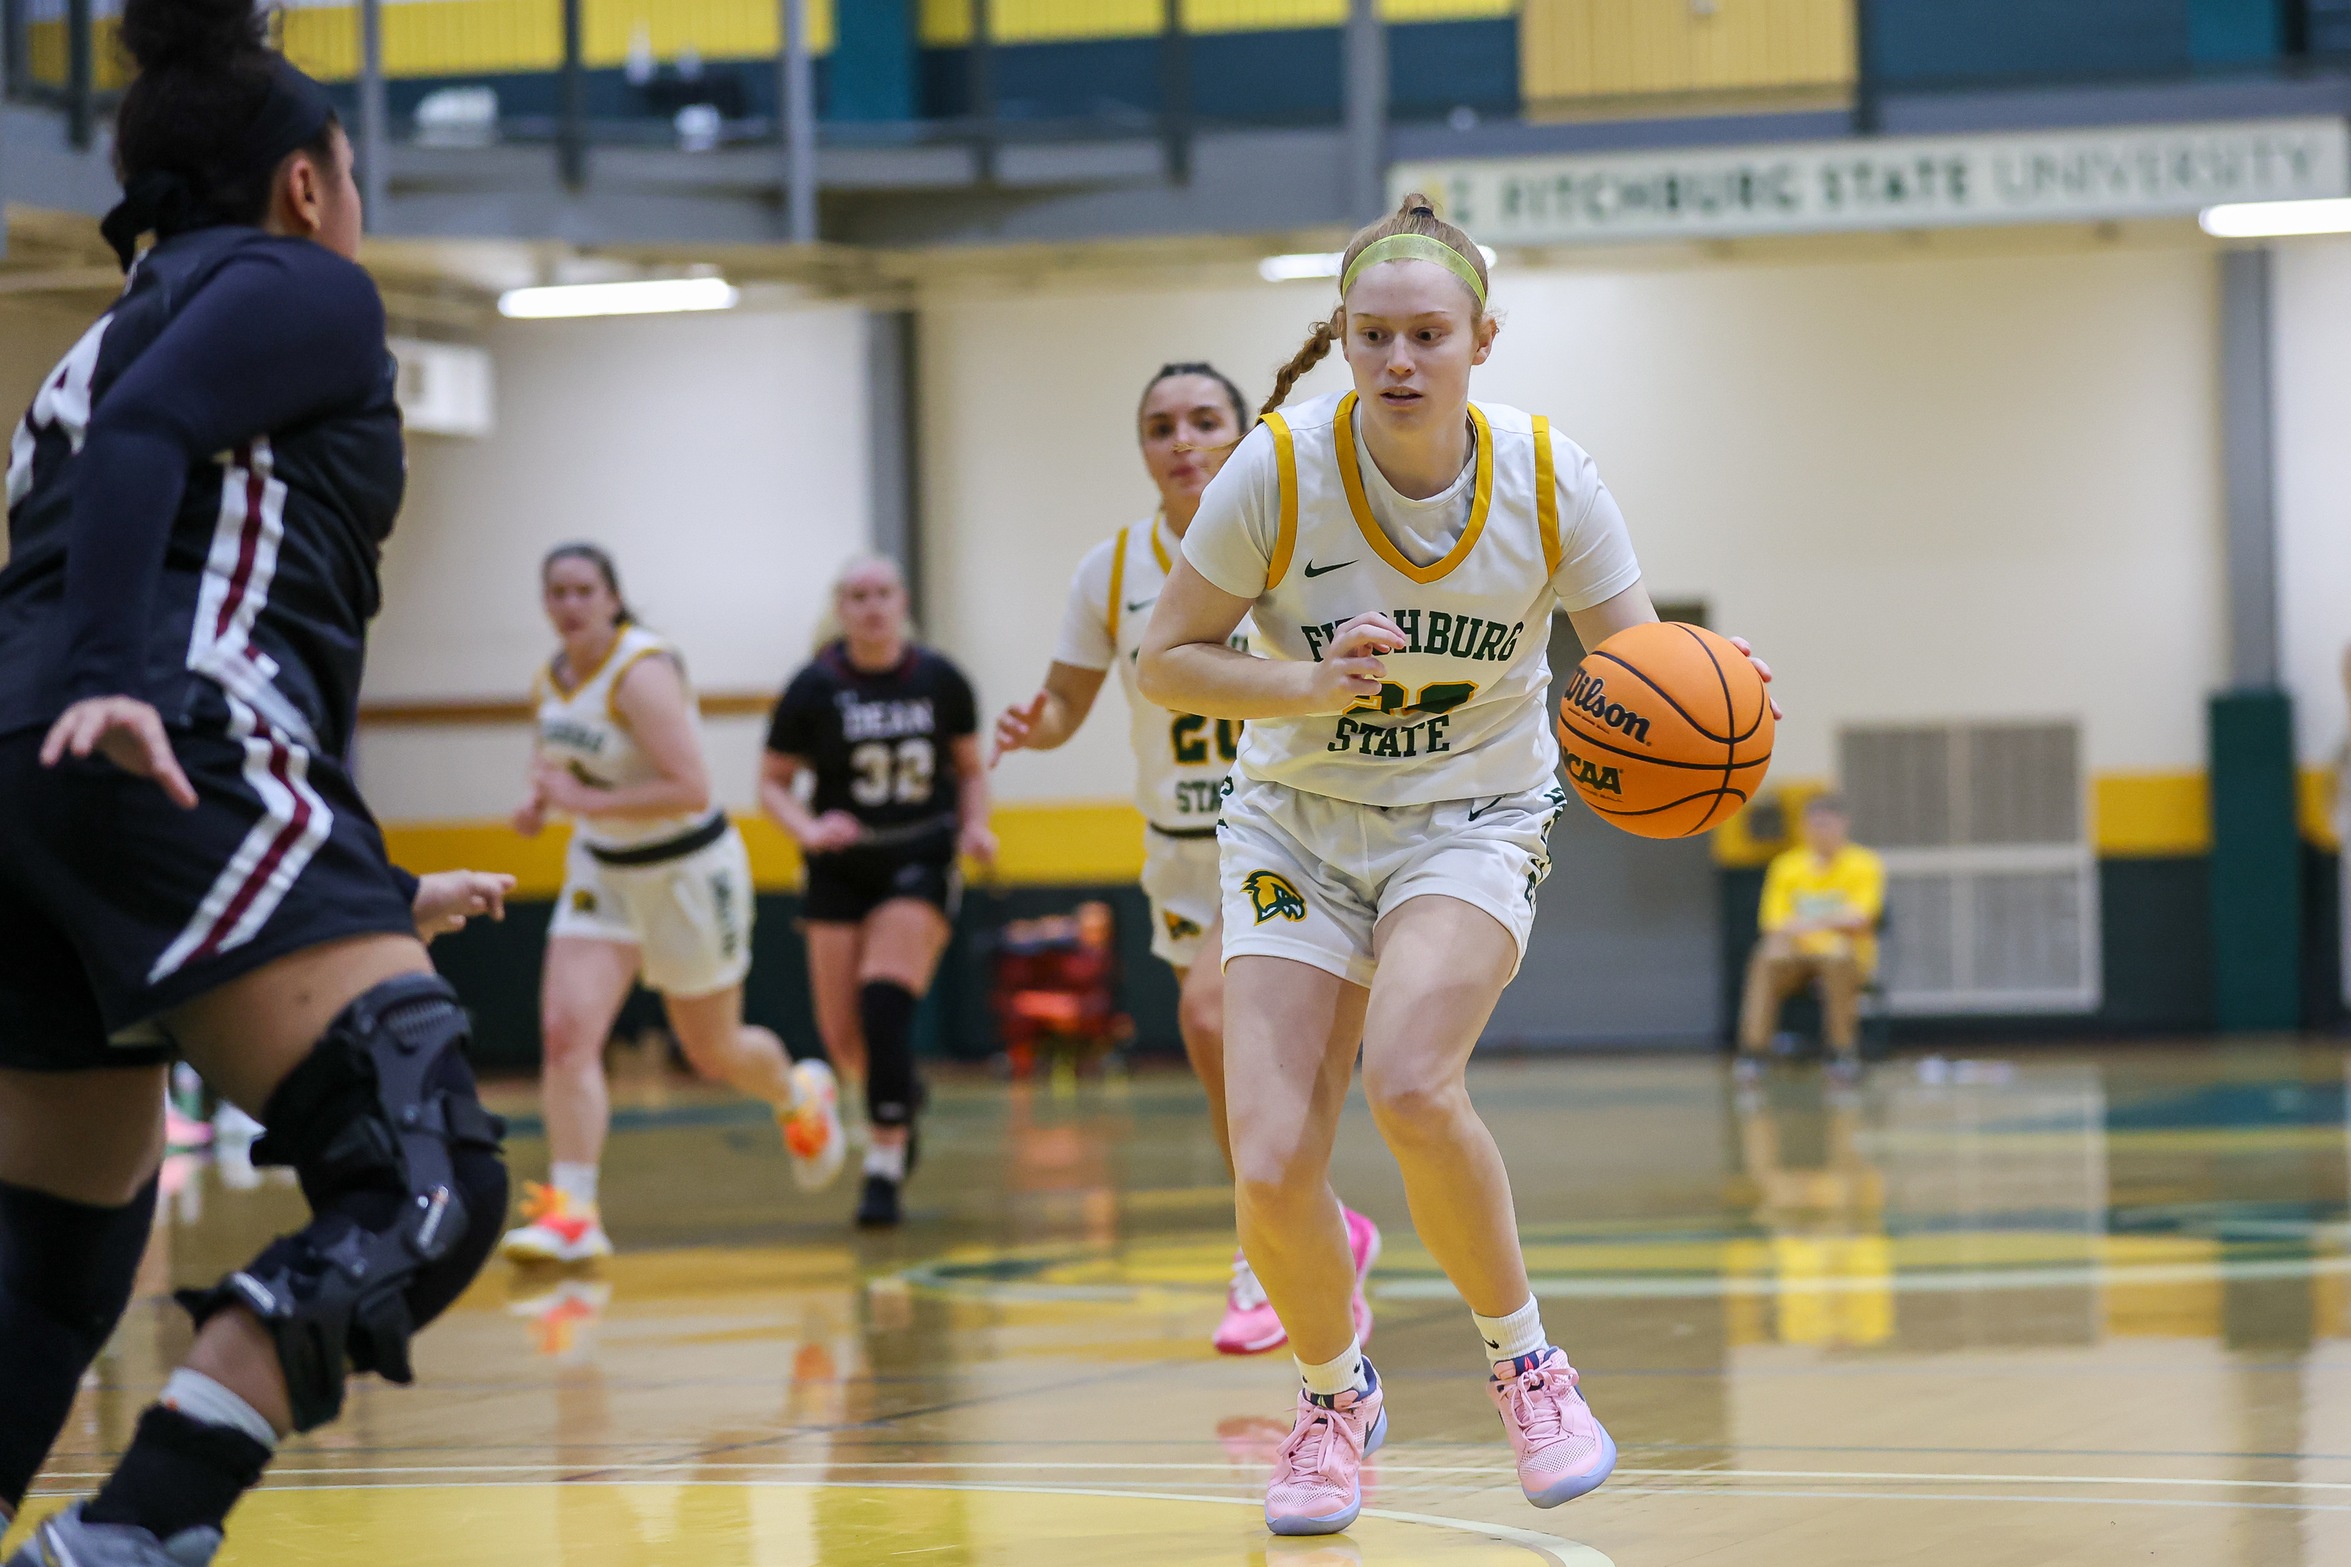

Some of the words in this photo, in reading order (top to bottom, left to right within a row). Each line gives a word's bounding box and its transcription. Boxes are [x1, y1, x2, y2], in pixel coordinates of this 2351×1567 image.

[1822, 155, 1969, 207] STATE
[1992, 134, 2320, 198] UNIVERSITY
[1301, 609, 1524, 663] FIHBURG
[1327, 714, 1451, 758] STATE
[849, 738, 936, 806] 32
